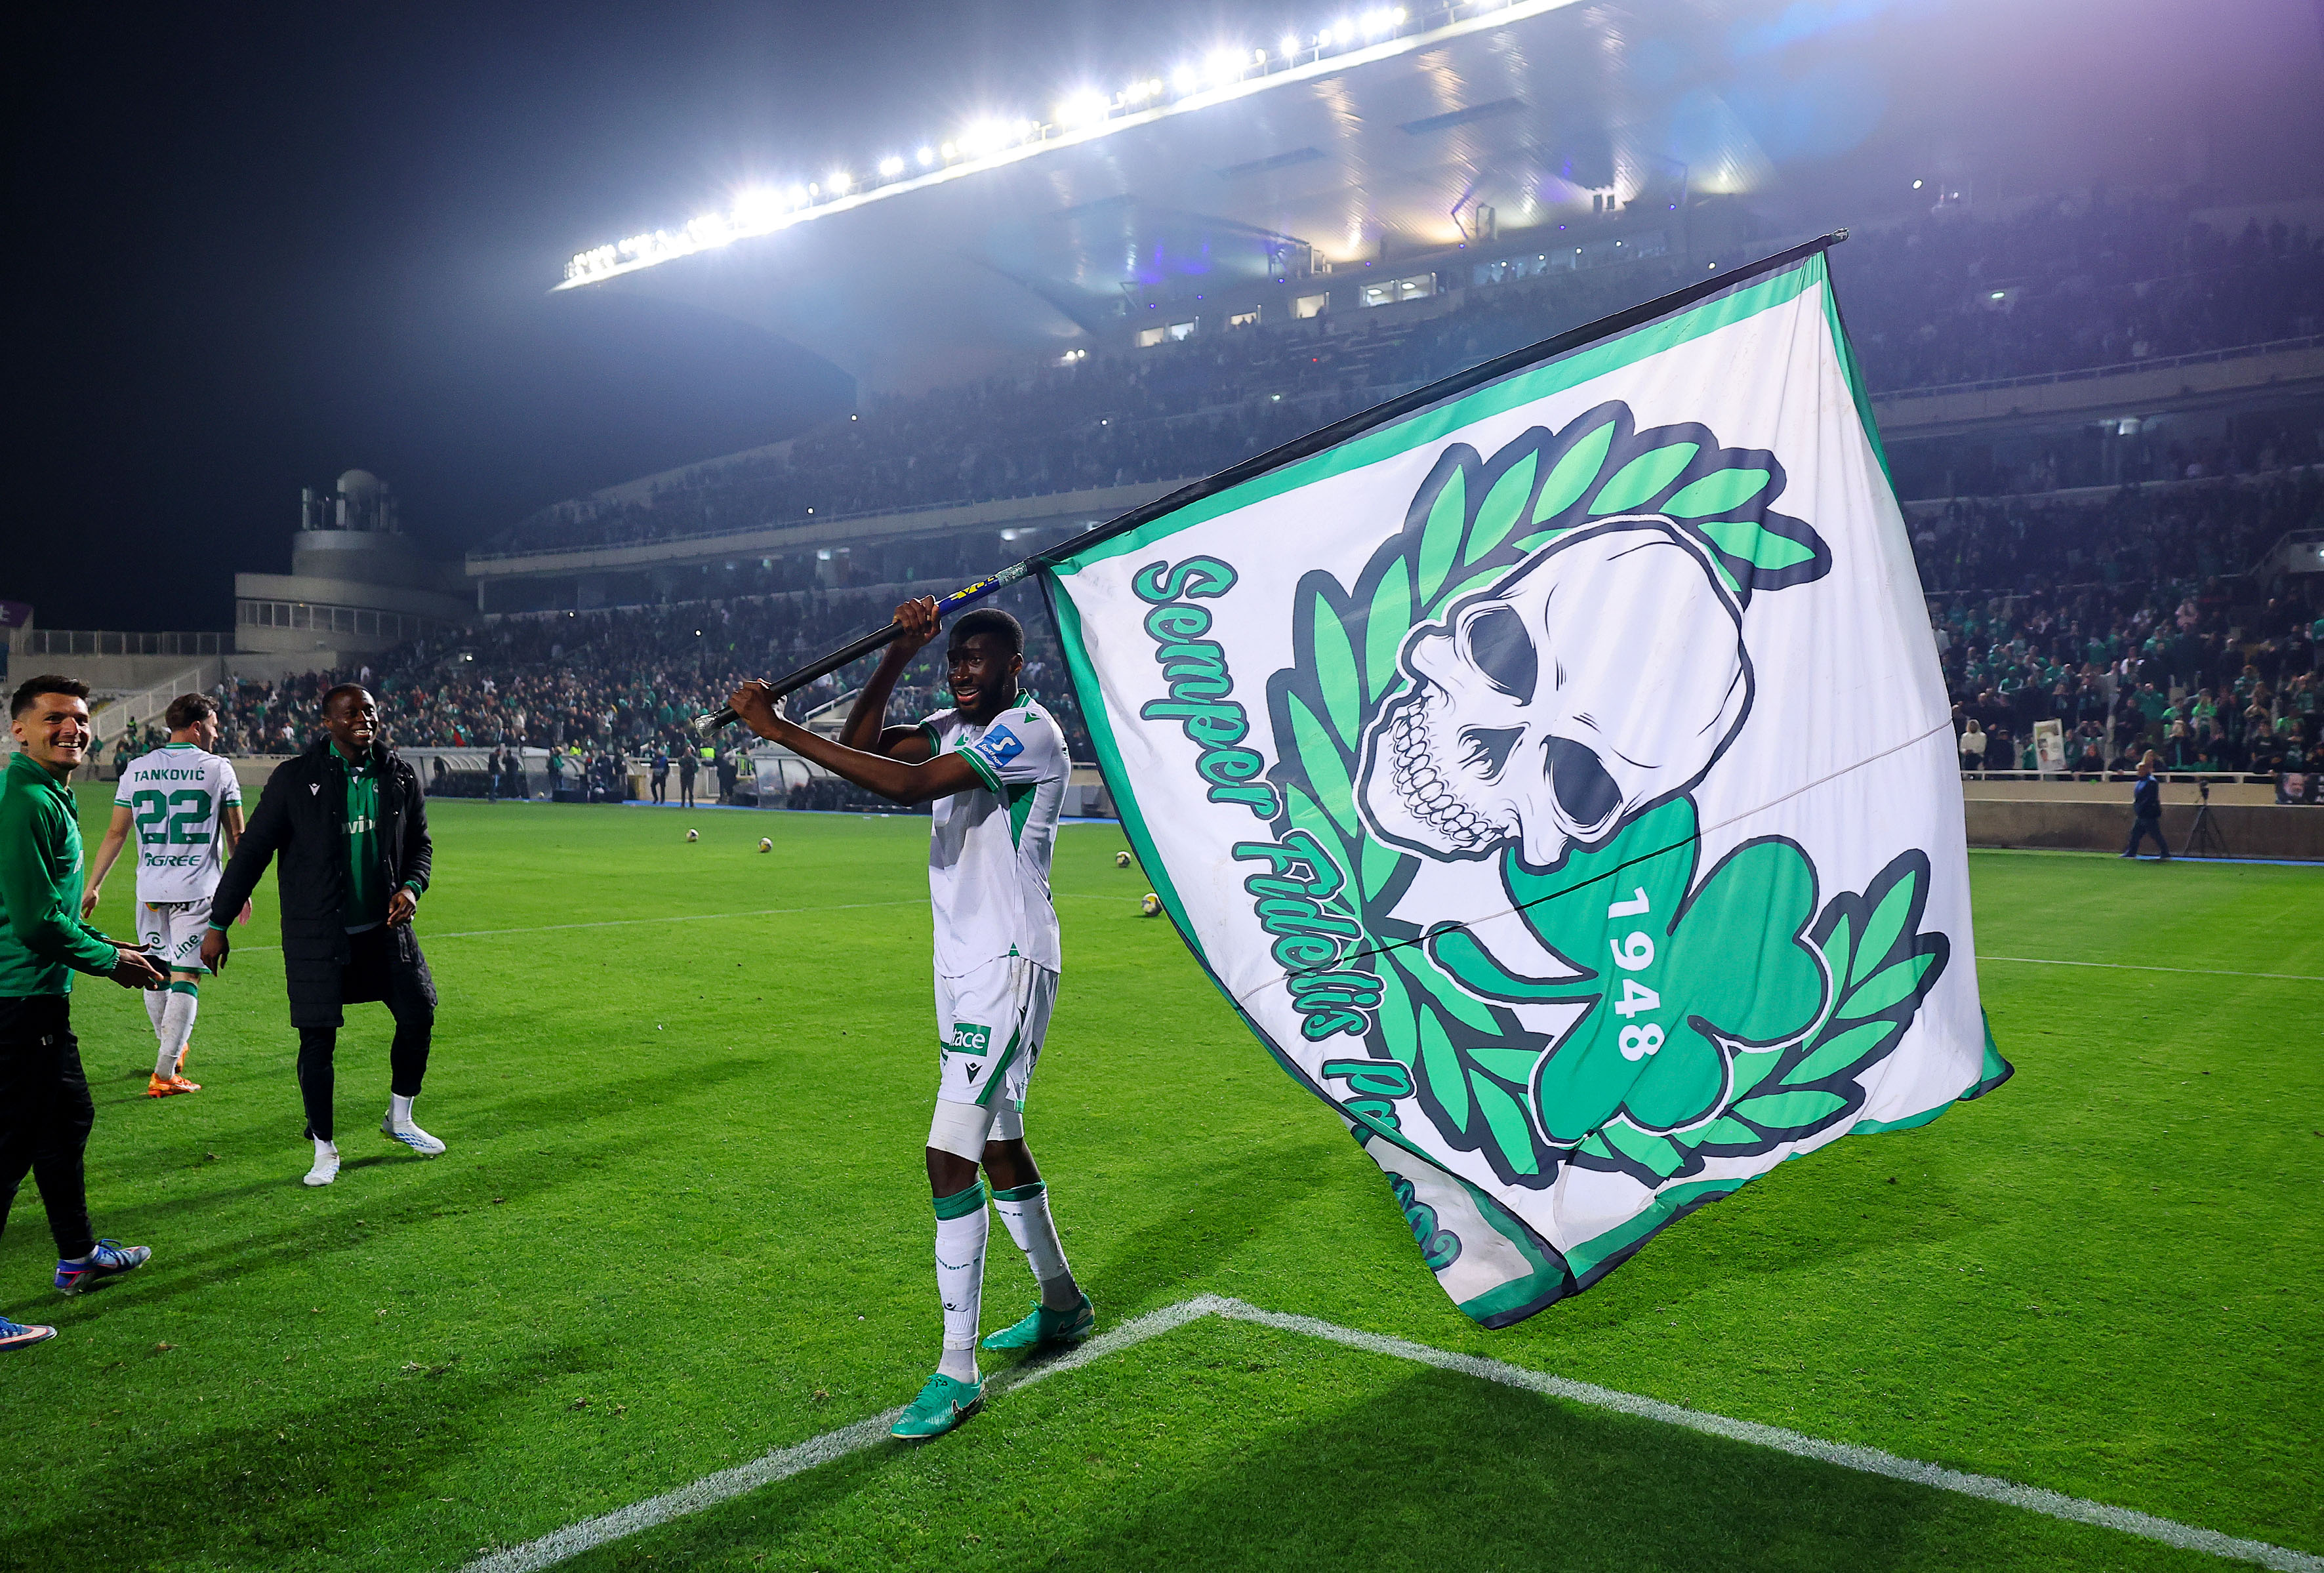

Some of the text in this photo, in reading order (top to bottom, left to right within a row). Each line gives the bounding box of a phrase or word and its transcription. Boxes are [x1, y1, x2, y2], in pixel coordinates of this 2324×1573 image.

[133, 789, 212, 844] 22
[134, 767, 205, 782] TANKOVIĆ
[1131, 555, 1281, 820] Semper
[1231, 830, 1385, 1042] Fidelis
[1608, 886, 1665, 1061] 1948
